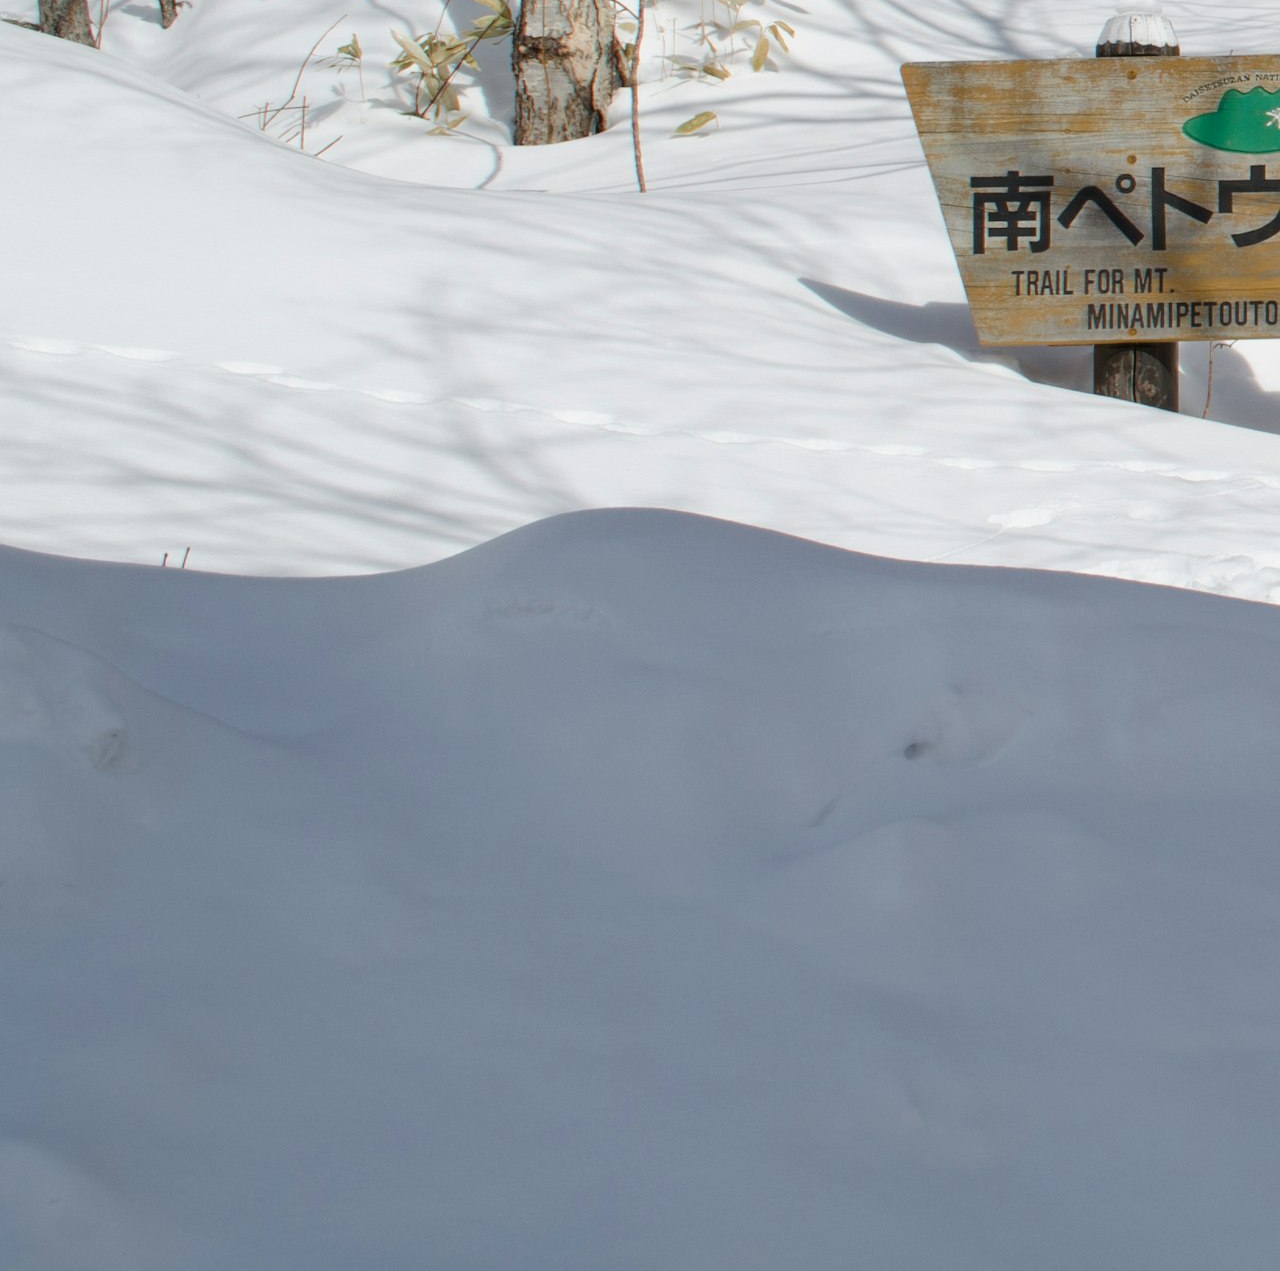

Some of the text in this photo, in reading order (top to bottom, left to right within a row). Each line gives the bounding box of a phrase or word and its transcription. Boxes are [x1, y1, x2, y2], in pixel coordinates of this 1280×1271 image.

[1182, 74, 1251, 103] DAISETSUZAN
[1012, 267, 1175, 297] TRAIL FOR MT.
